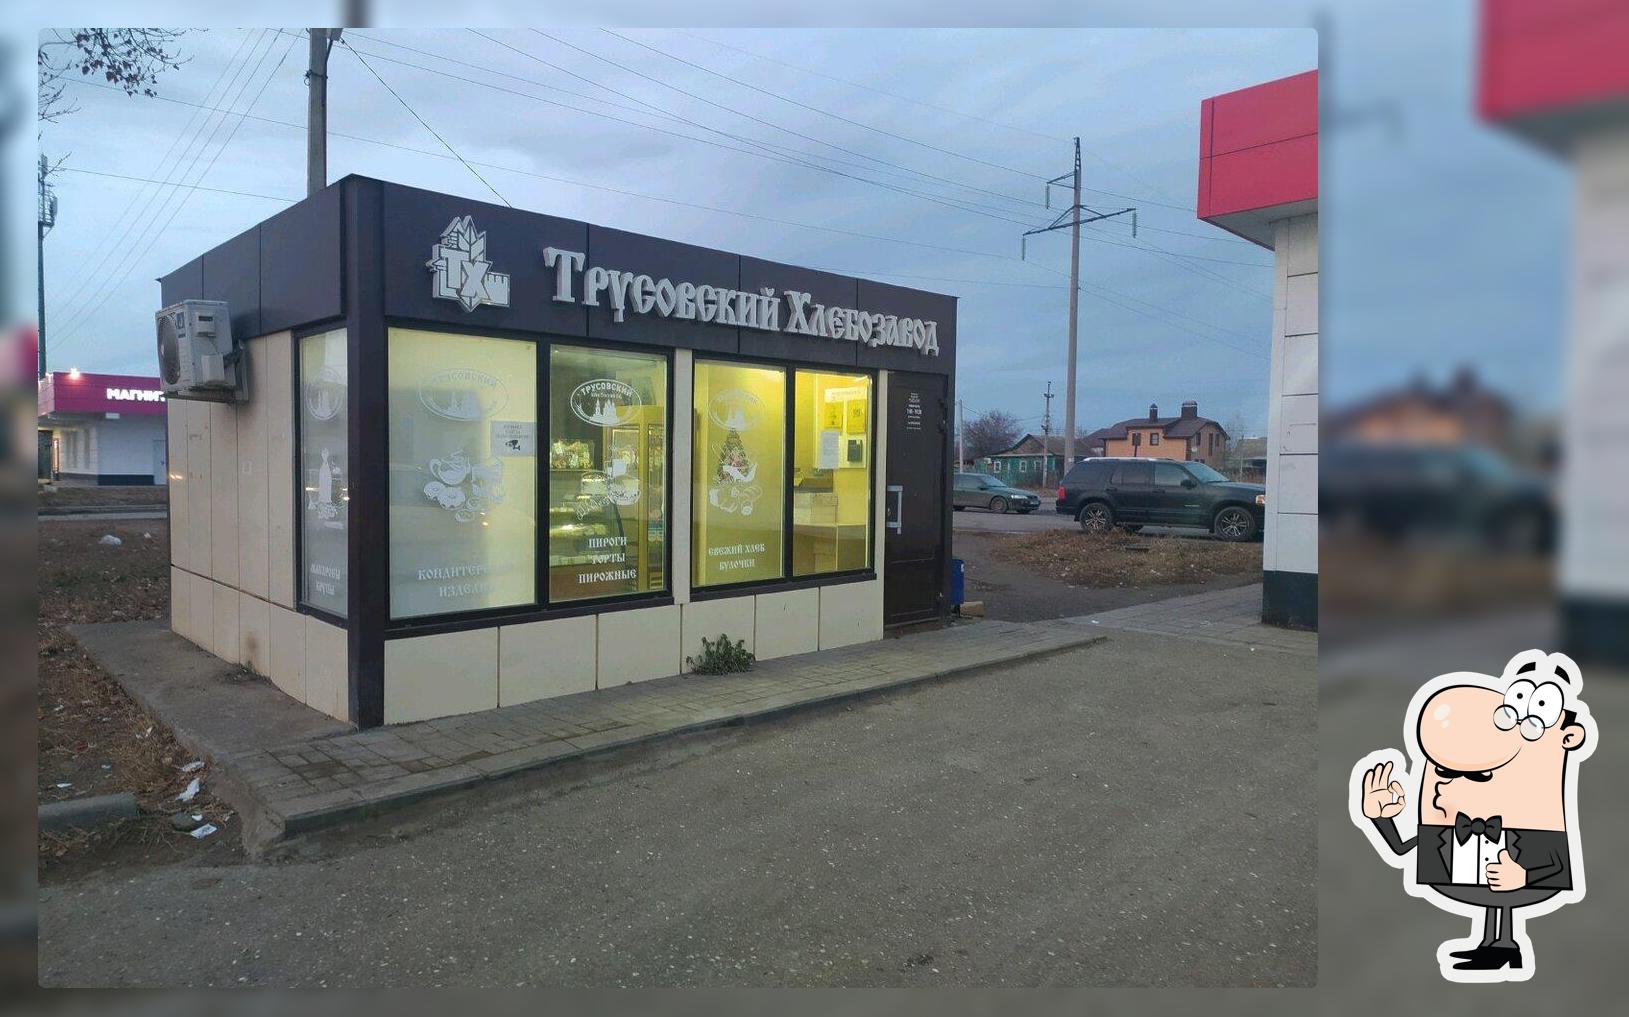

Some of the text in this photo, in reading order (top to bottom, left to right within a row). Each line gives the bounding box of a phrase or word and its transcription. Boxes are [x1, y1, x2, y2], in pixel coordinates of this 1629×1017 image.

[580, 382, 634, 397] ТРУСОВСКИЙ
[588, 536, 627, 549] ПИРОГИ
[592, 552, 626, 565] ТОРТЫ
[578, 568, 638, 584] ПИРОЖНЫЕ
